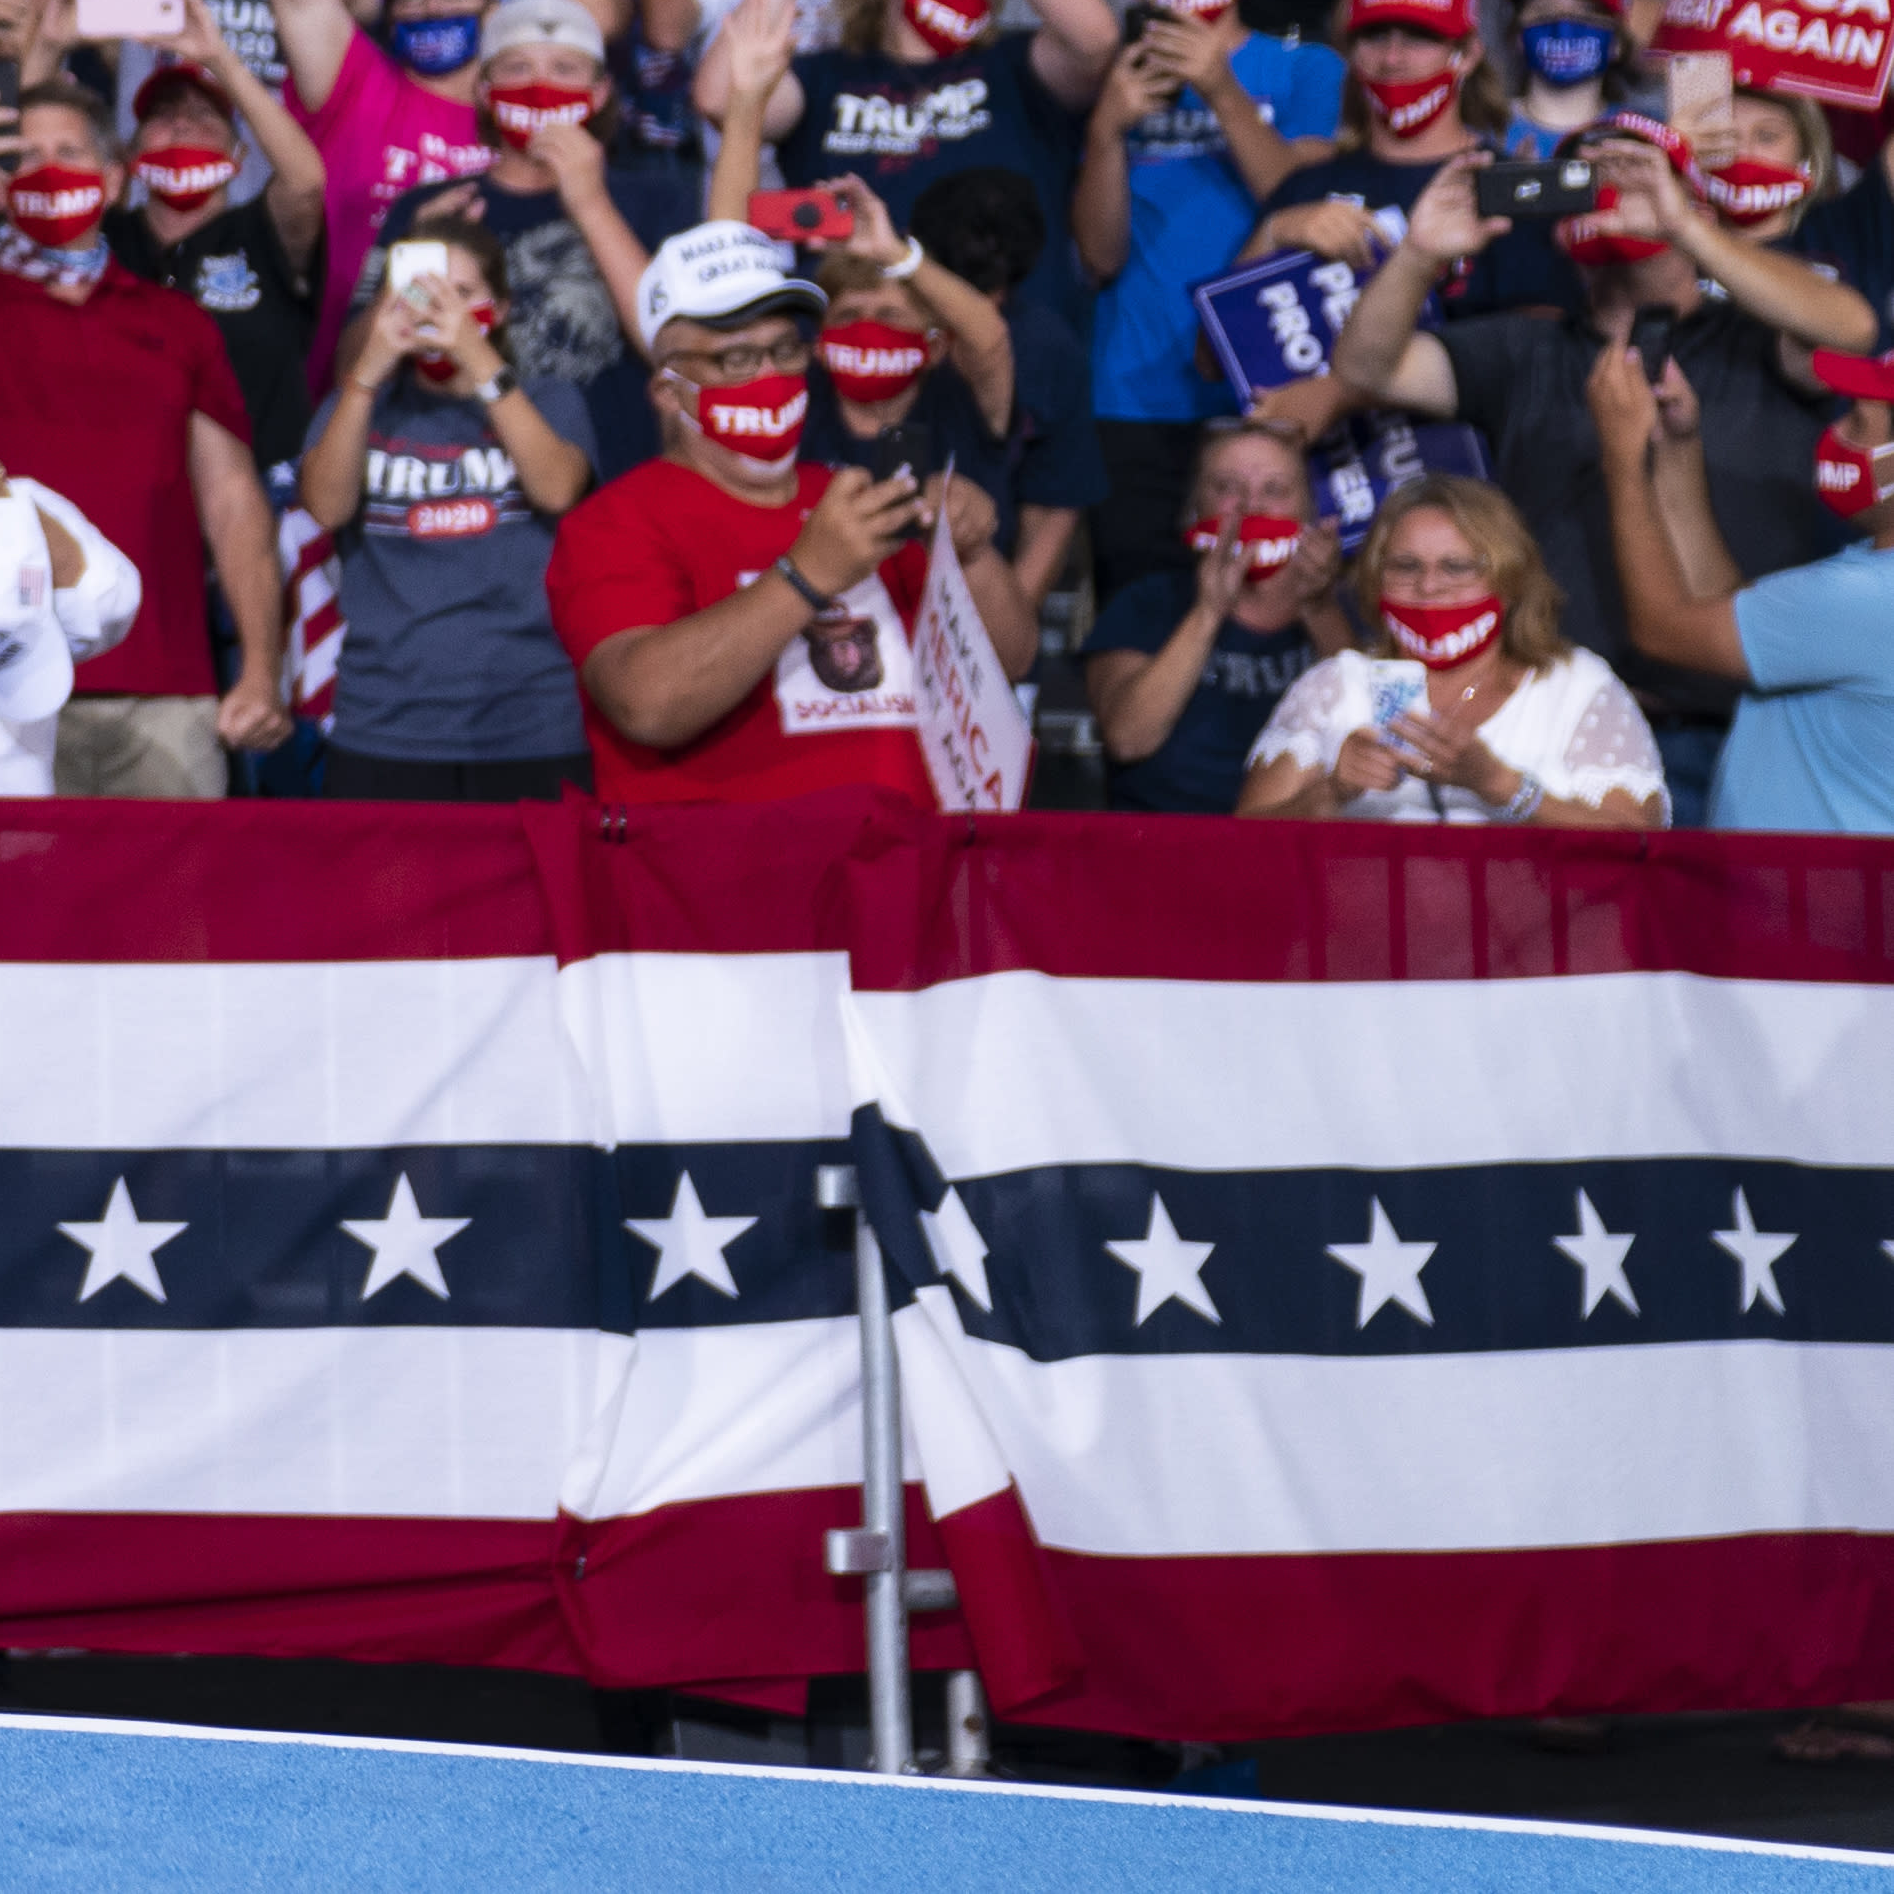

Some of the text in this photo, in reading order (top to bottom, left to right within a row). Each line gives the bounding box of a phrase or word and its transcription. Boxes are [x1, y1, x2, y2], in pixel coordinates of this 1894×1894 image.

[1725, 1, 1886, 70] AGAIN
[495, 100, 589, 133] TRUMP
[834, 78, 989, 140] TRUMP
[137, 160, 236, 196] TRUMP
[1710, 179, 1806, 212] RUMP
[13, 186, 103, 220] TRUMP
[825, 341, 925, 377] TRUMP
[367, 448, 517, 500] TRUM
[416, 503, 490, 536] 2020
[1384, 609, 1500, 659] TRUMP
